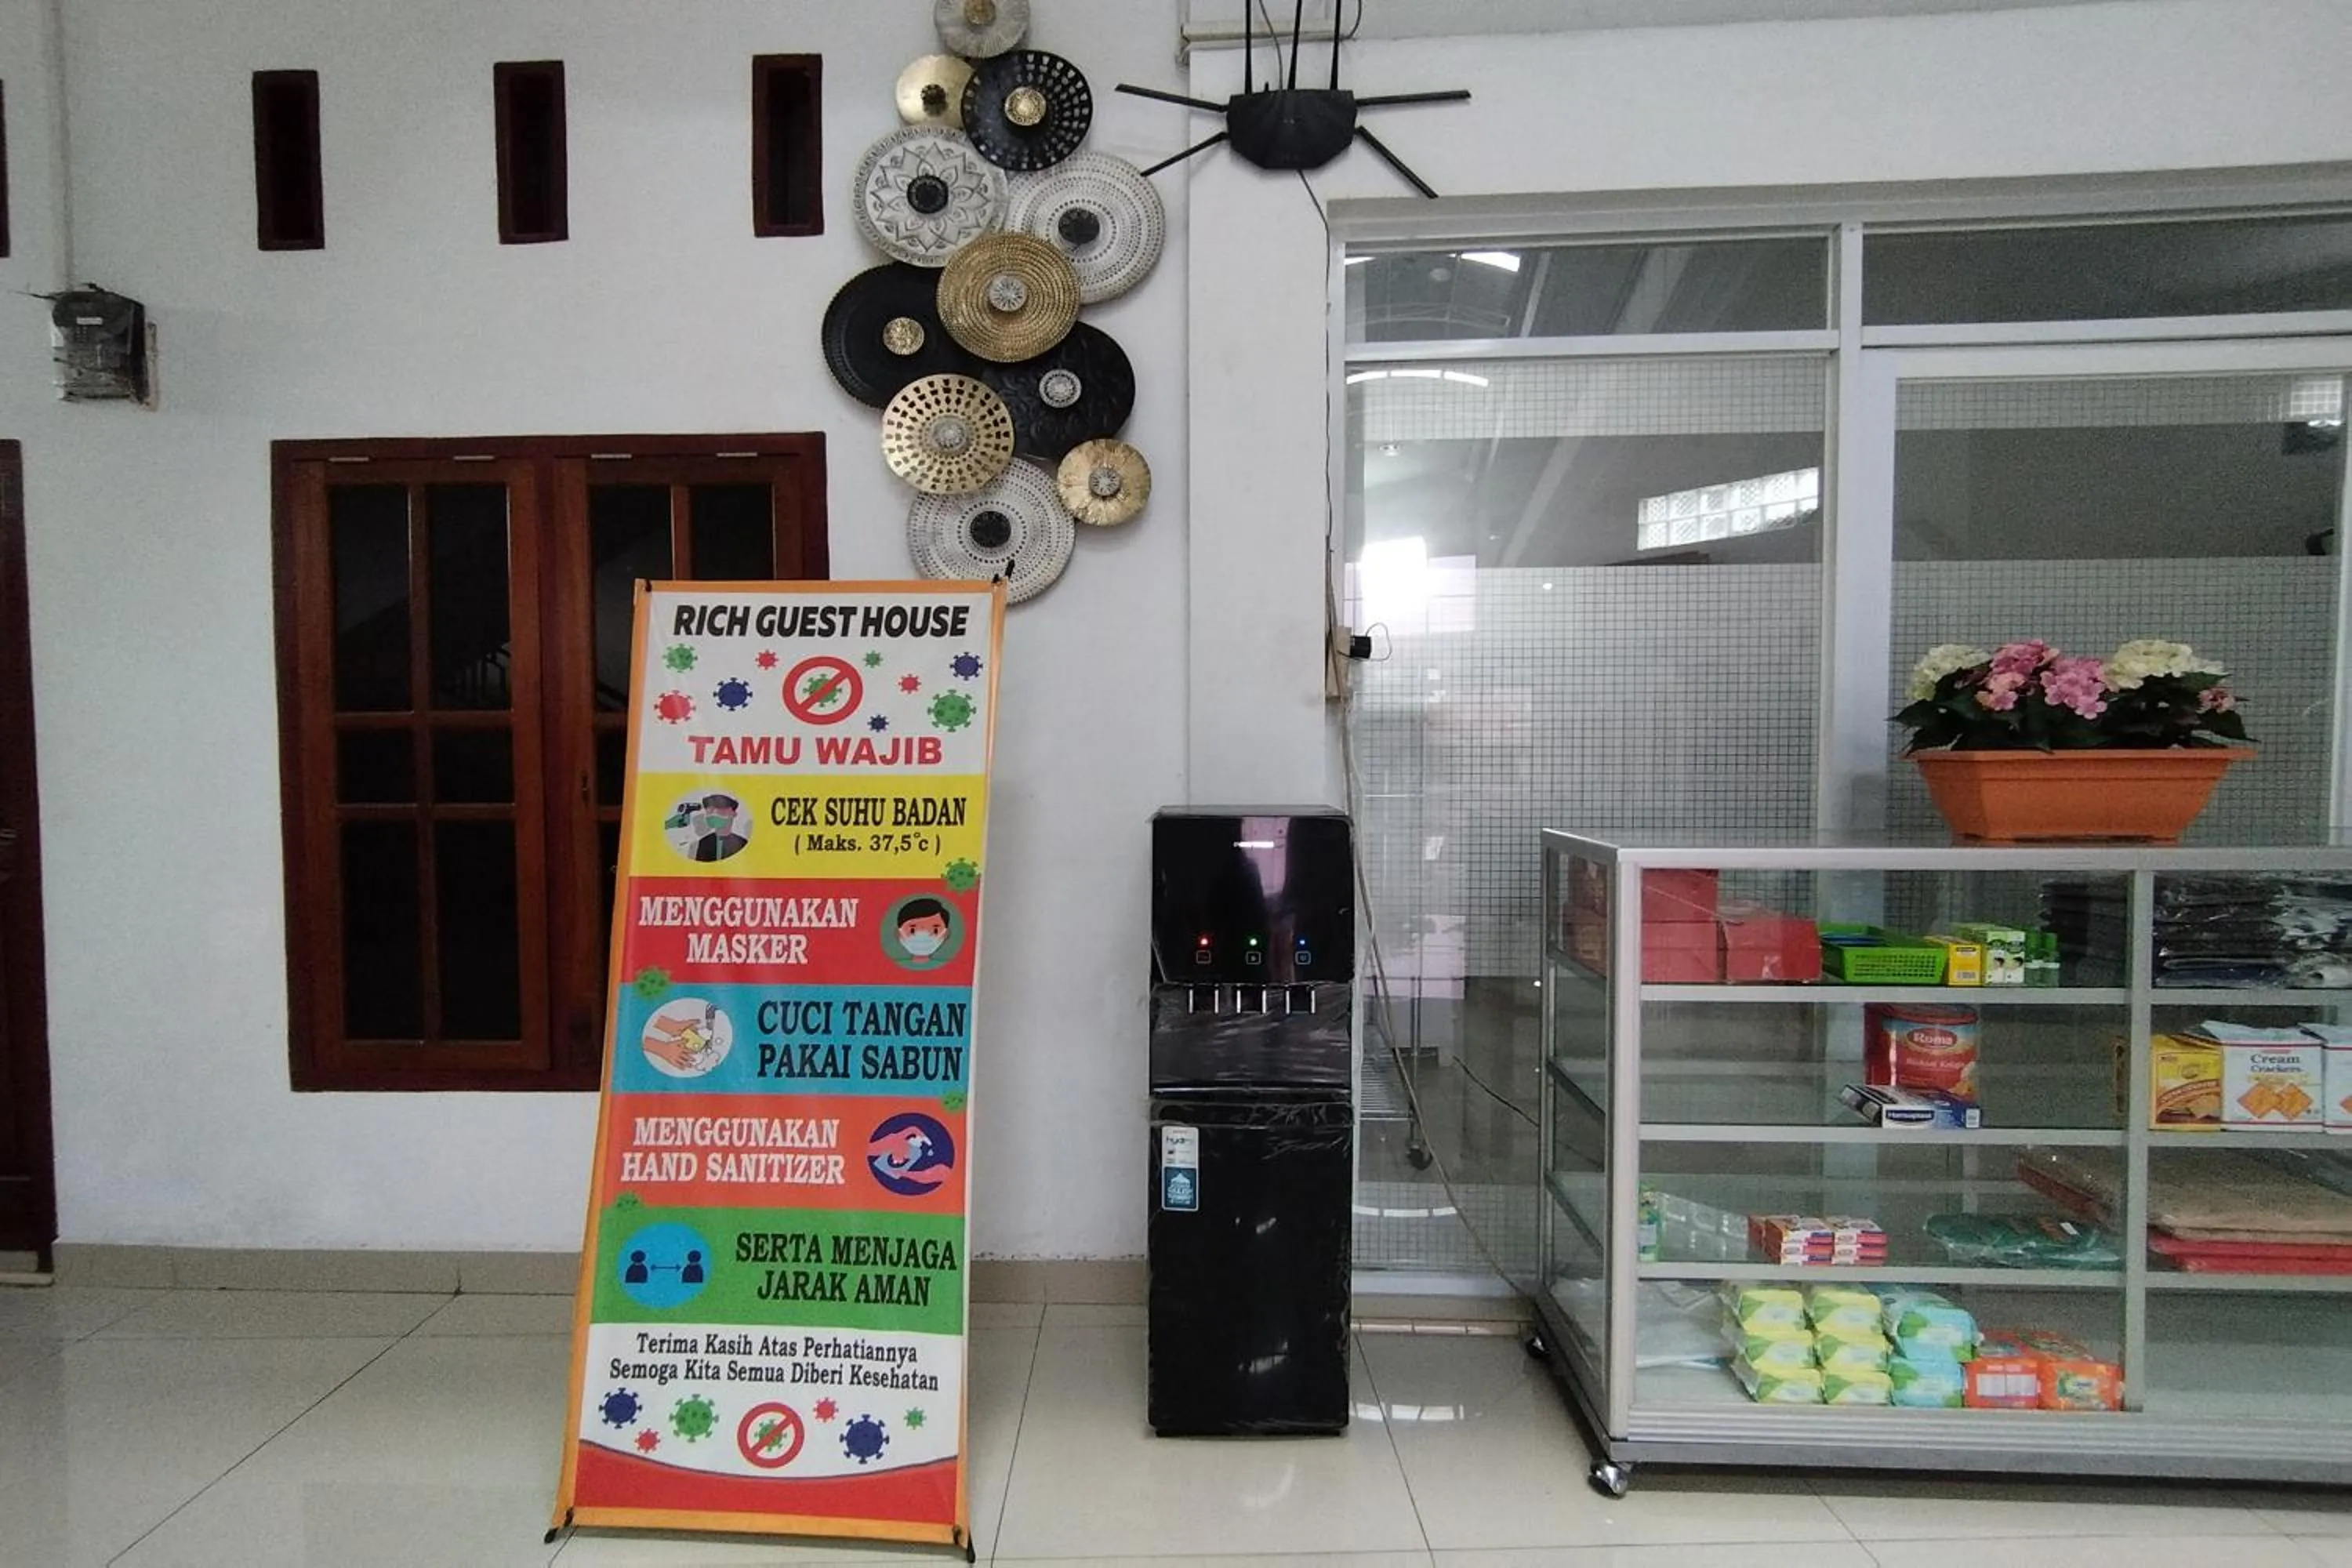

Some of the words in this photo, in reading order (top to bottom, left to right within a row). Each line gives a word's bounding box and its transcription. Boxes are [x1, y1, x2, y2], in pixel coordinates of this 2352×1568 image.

[673, 604, 748, 636] RICH
[756, 605, 858, 637] GUEST
[861, 606, 969, 637] HOUSE
[688, 735, 800, 764] TAMU
[815, 737, 942, 766] WAJIB
[771, 797, 818, 826] CEK
[824, 797, 885, 826] SUHU
[891, 797, 967, 826] BADAN
[806, 834, 862, 853] Maks.
[638, 895, 859, 928] MENGGUNAKAN
[686, 933, 808, 964] MASKER
[757, 1001, 839, 1036] CUCI
[843, 1002, 967, 1038] TANGAN
[757, 1044, 851, 1079] PAKAI
[862, 1046, 962, 1081] SABUN
[2249, 1053, 2301, 1064] Cream
[633, 1117, 840, 1148] MENGGUNAKAN
[620, 1152, 697, 1182] HAND
[705, 1153, 845, 1185] SANITIZER
[735, 1232, 822, 1265] SERTA
[830, 1236, 957, 1271] MENJAGA
[757, 1270, 847, 1301] JARAK
[855, 1274, 931, 1306] AMAN
[637, 1332, 698, 1355] Terima
[705, 1334, 753, 1356] Kasih
[759, 1335, 797, 1356] Atas
[803, 1337, 917, 1369] Perhatiannya
[610, 1358, 678, 1385] Semoga
[683, 1359, 720, 1381] Kita
[726, 1362, 784, 1383] Semua
[790, 1362, 844, 1385] Diberi
[850, 1364, 939, 1392] Kesehatan
